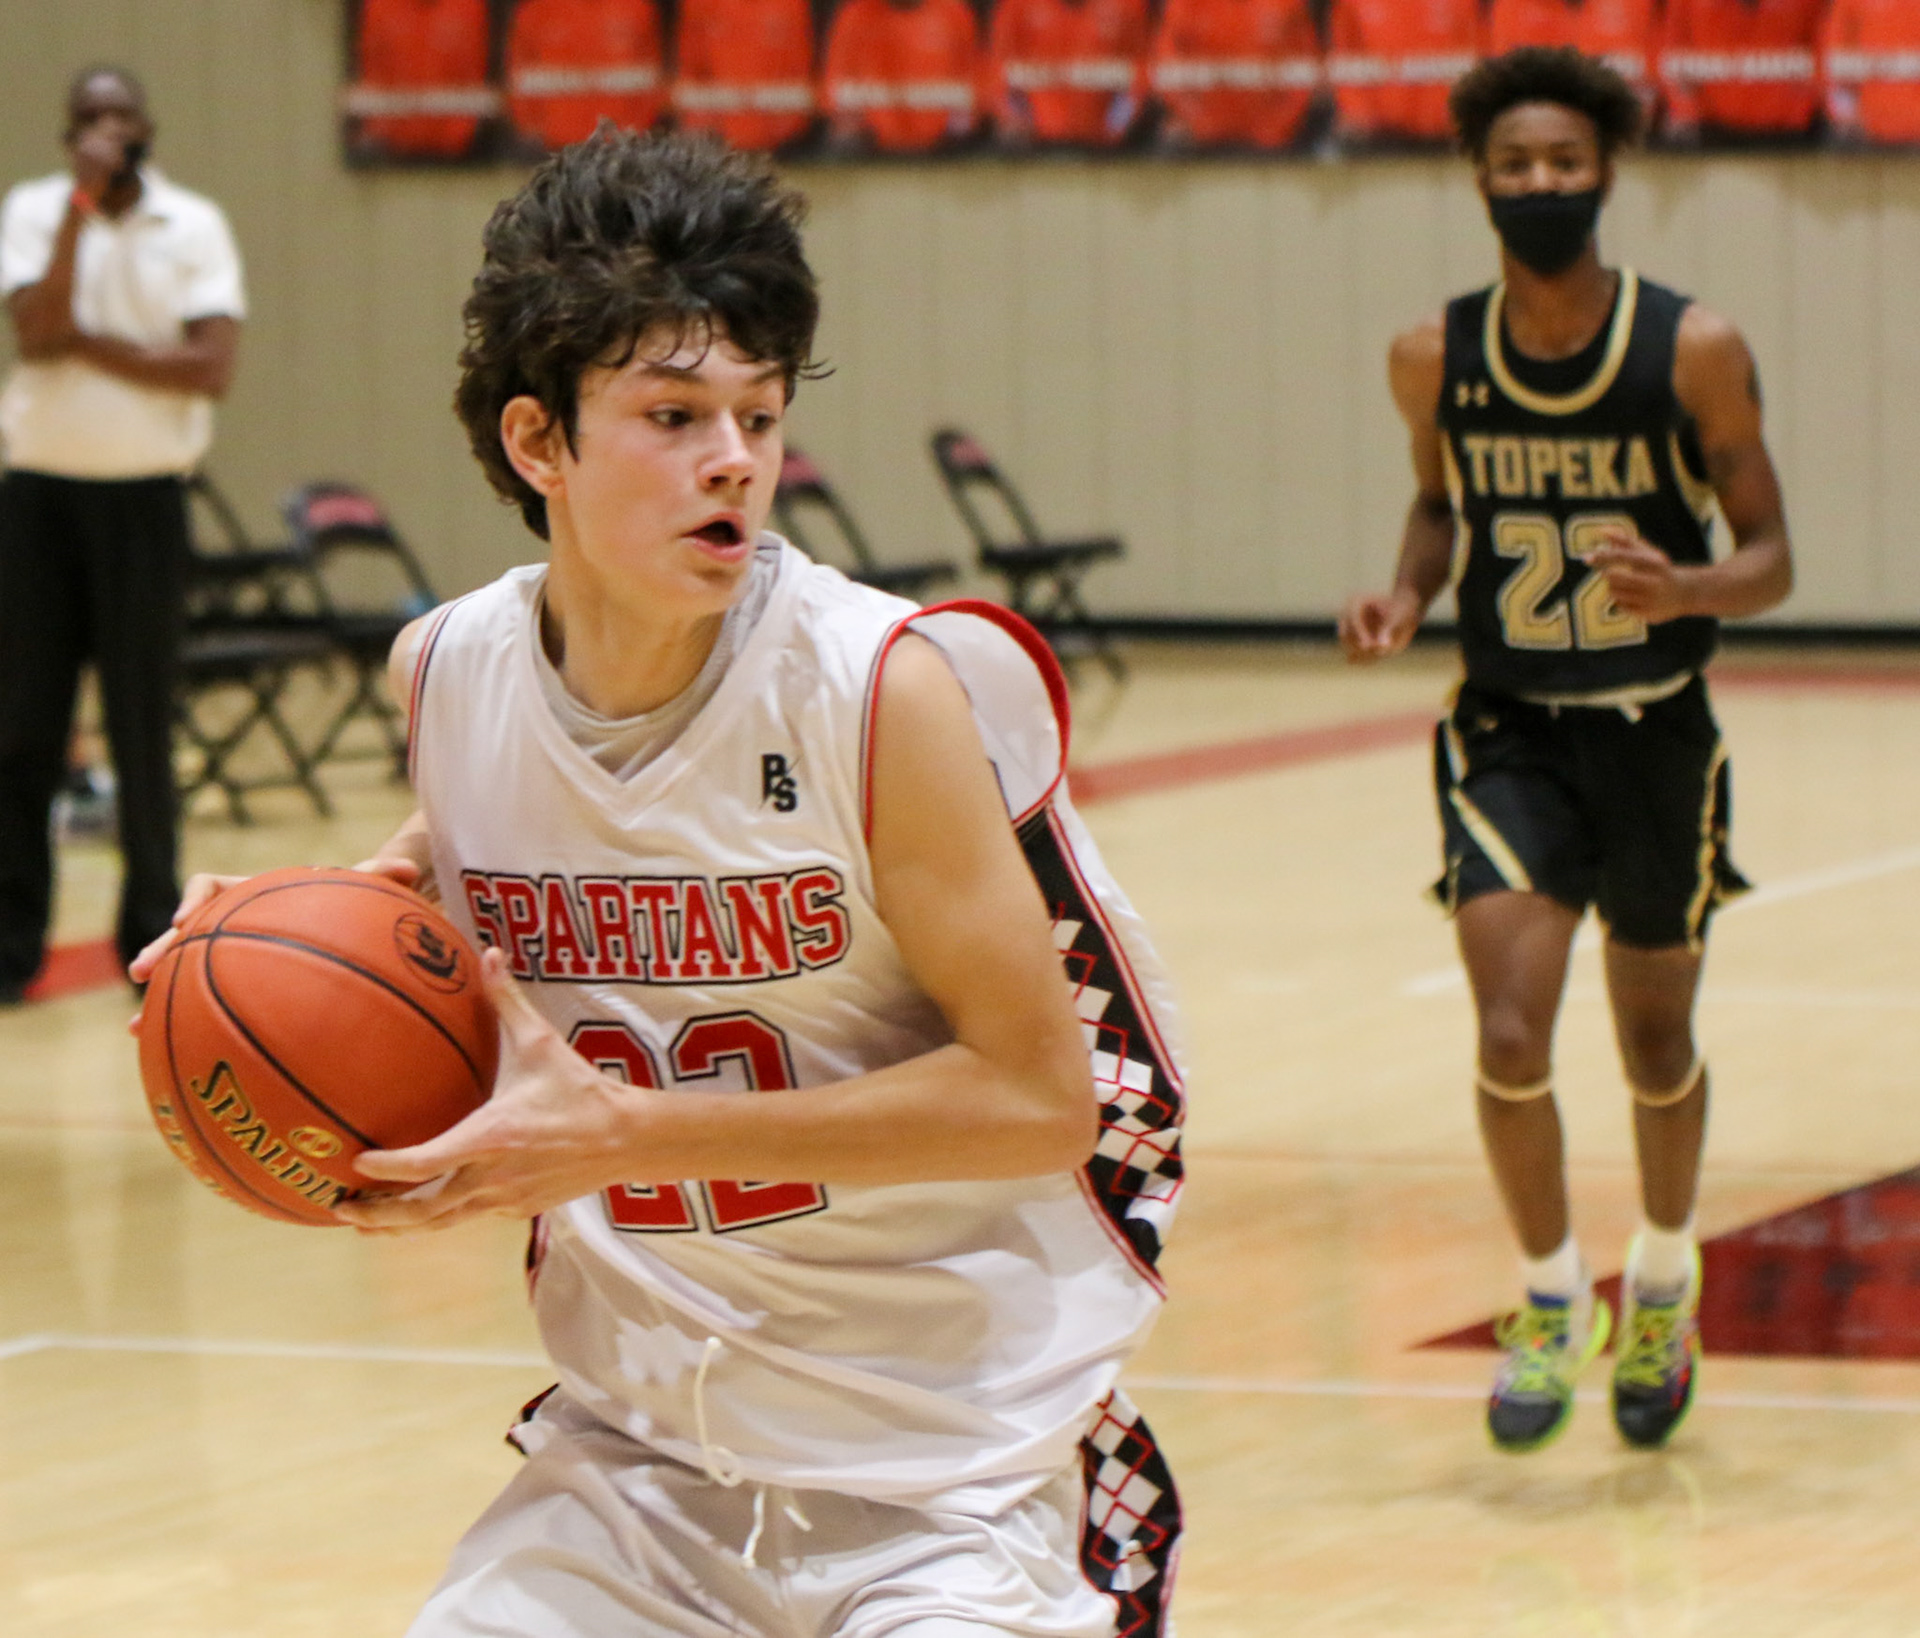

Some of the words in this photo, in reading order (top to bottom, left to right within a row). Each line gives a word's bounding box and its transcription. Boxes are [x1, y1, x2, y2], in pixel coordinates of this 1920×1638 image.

[1463, 435, 1657, 498] TOPEKA
[1491, 514, 1648, 650] 22
[461, 867, 851, 985] SPARTANS
[189, 1058, 361, 1211] SPALDIN
